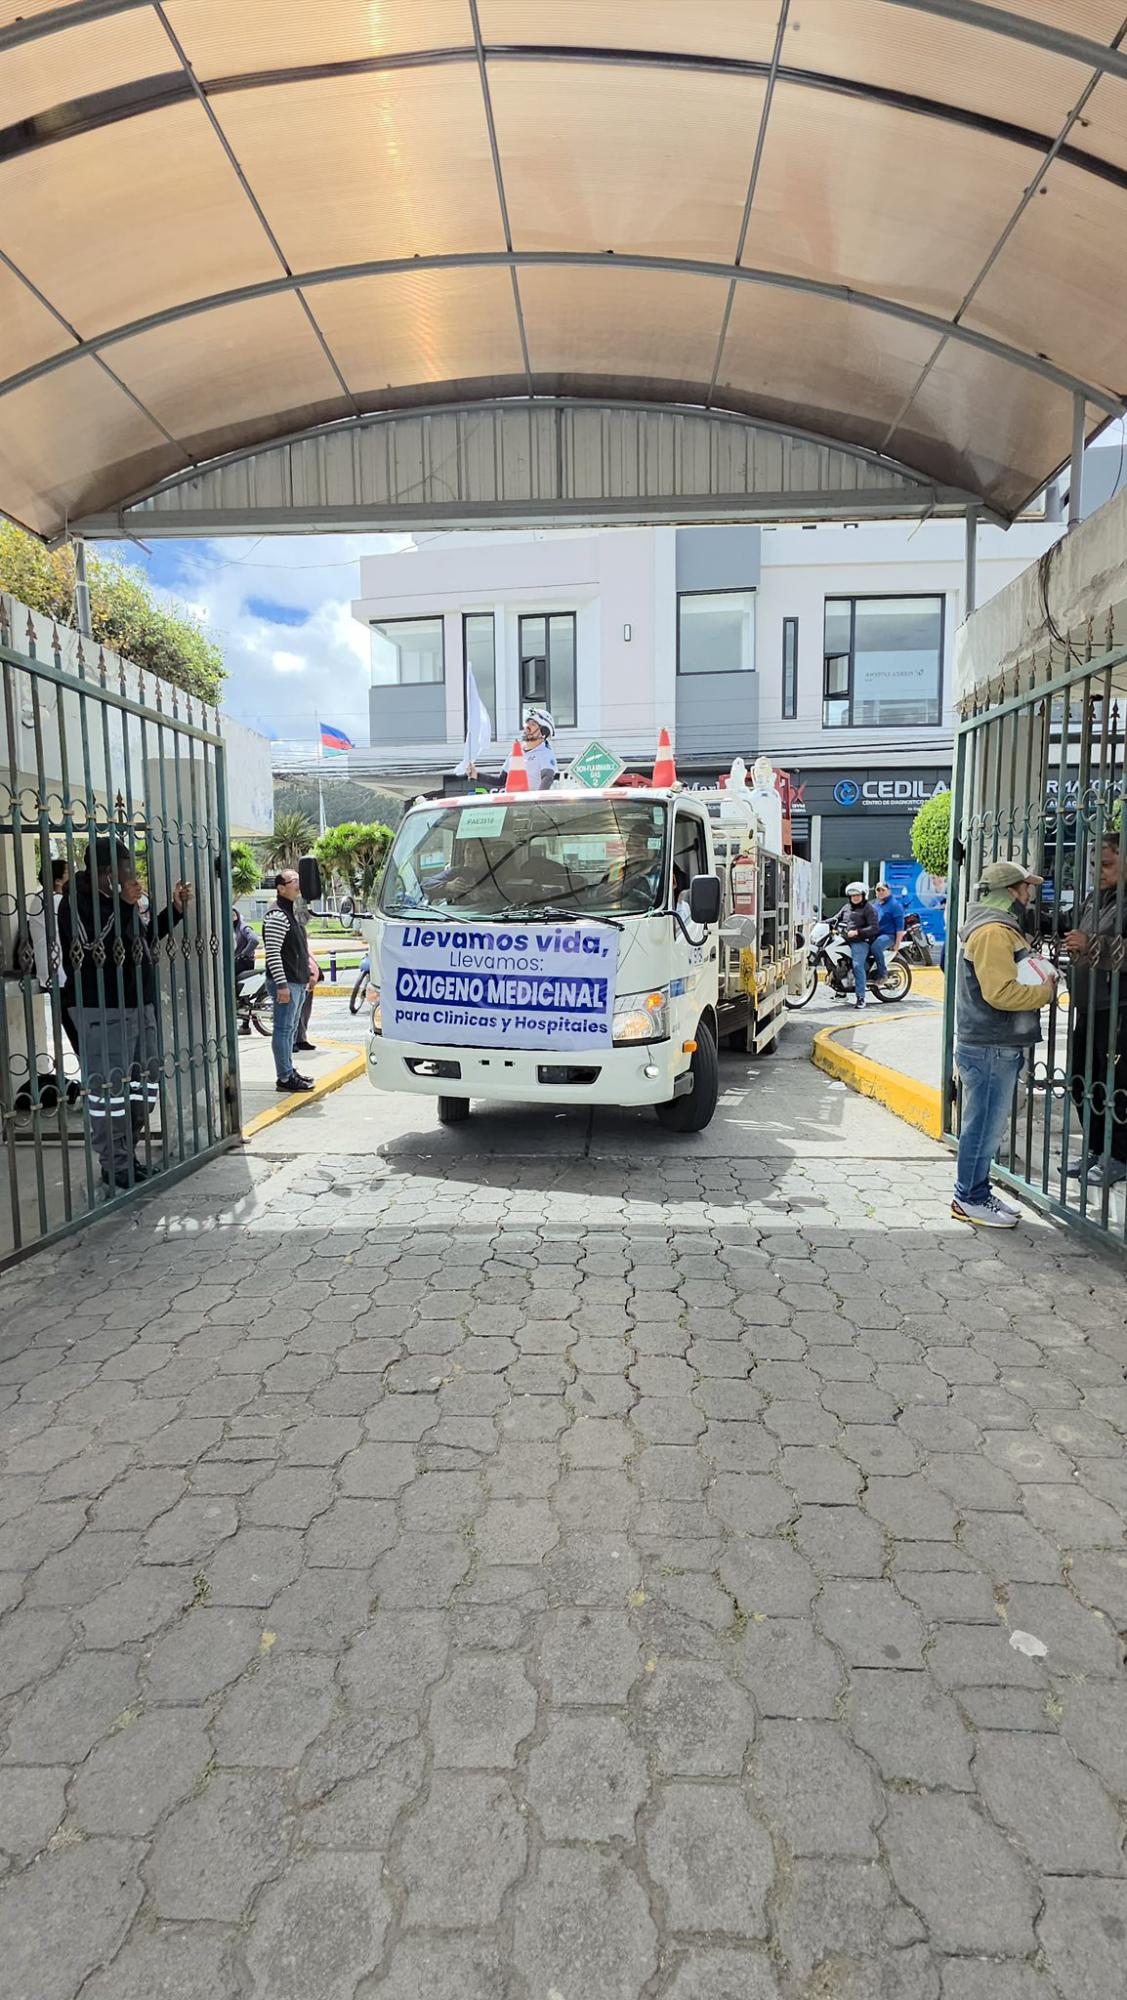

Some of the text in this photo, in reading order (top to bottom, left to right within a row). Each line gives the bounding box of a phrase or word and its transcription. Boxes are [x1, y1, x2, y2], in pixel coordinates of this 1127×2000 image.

[402, 927, 609, 957] Llevamos vida,
[450, 951, 544, 971] Llevamos:
[399, 972, 604, 1008] OXIGENO MEDICINAL
[395, 1009, 609, 1035] para Clinicas y Hospitales
